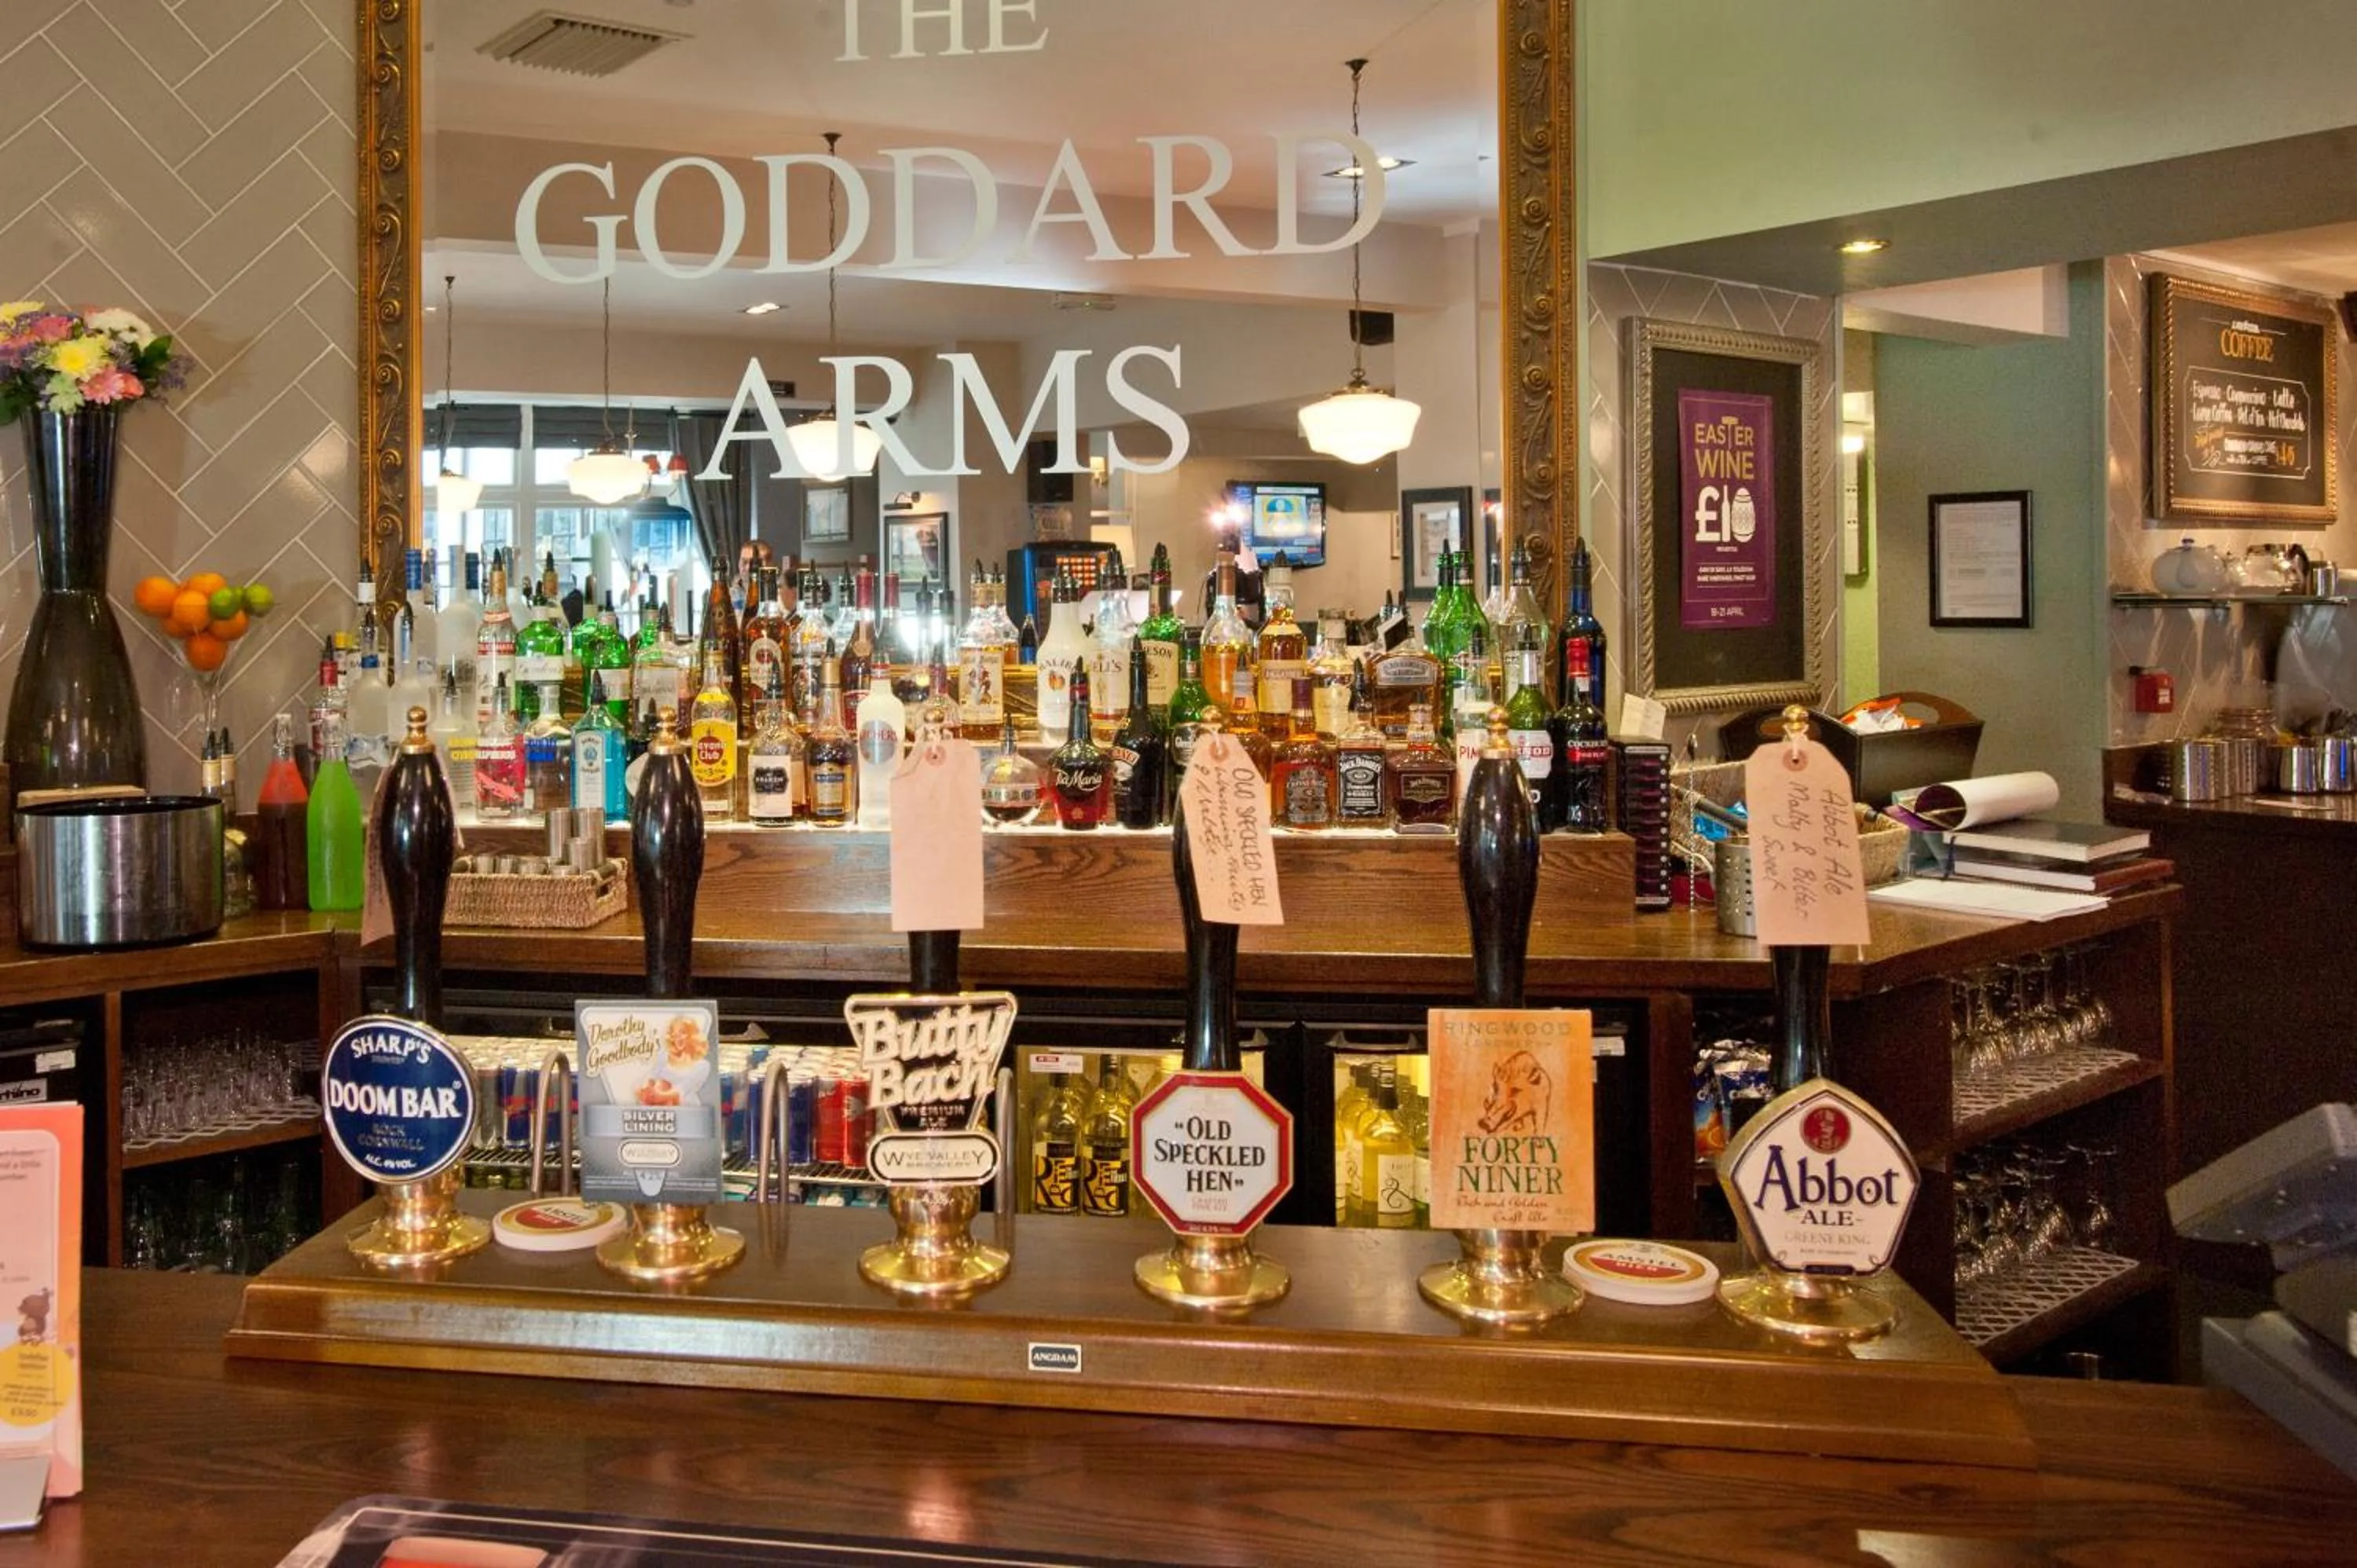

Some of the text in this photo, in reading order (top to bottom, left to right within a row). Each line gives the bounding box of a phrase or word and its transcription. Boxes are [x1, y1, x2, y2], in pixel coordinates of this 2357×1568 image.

[834, 0, 1049, 63] THE
[515, 127, 1387, 284] GODDARD
[2221, 329, 2273, 362] COFFEE
[695, 344, 1191, 481] ARMS
[2273, 387, 2294, 409] Latte
[1695, 416, 1754, 448] EASTER
[1695, 449, 1754, 479] WINE
[1695, 485, 1756, 542] £10
[699, 752, 720, 760] Club
[1070, 770, 1102, 792] Maria
[1233, 768, 1255, 799] OLD
[1772, 781, 1809, 831] Malty
[1820, 789, 1853, 896] Abbot Ale
[589, 1015, 645, 1045] Dorothy
[852, 1004, 1013, 1062] Butty
[1445, 1021, 1572, 1036] RINGWOOD
[350, 1033, 431, 1064] SHARP'S
[588, 1031, 661, 1068] Goodbody's
[867, 1054, 995, 1110] Bach
[329, 1078, 463, 1119] DOOM BAR
[900, 1105, 966, 1116] PREMIUM
[623, 1111, 675, 1122] SILVER
[625, 1121, 676, 1132] LINING
[918, 1117, 948, 1127] ALE
[929, 1149, 986, 1165] VALLEY
[1154, 1138, 1266, 1167] SPECKLED
[1464, 1137, 1558, 1163] FORTY
[1458, 1166, 1563, 1195] NINER
[1753, 1145, 1900, 1212] Abbot
[1801, 1209, 1854, 1225] ALE
[1033, 1352, 1077, 1364] ANGRAM
